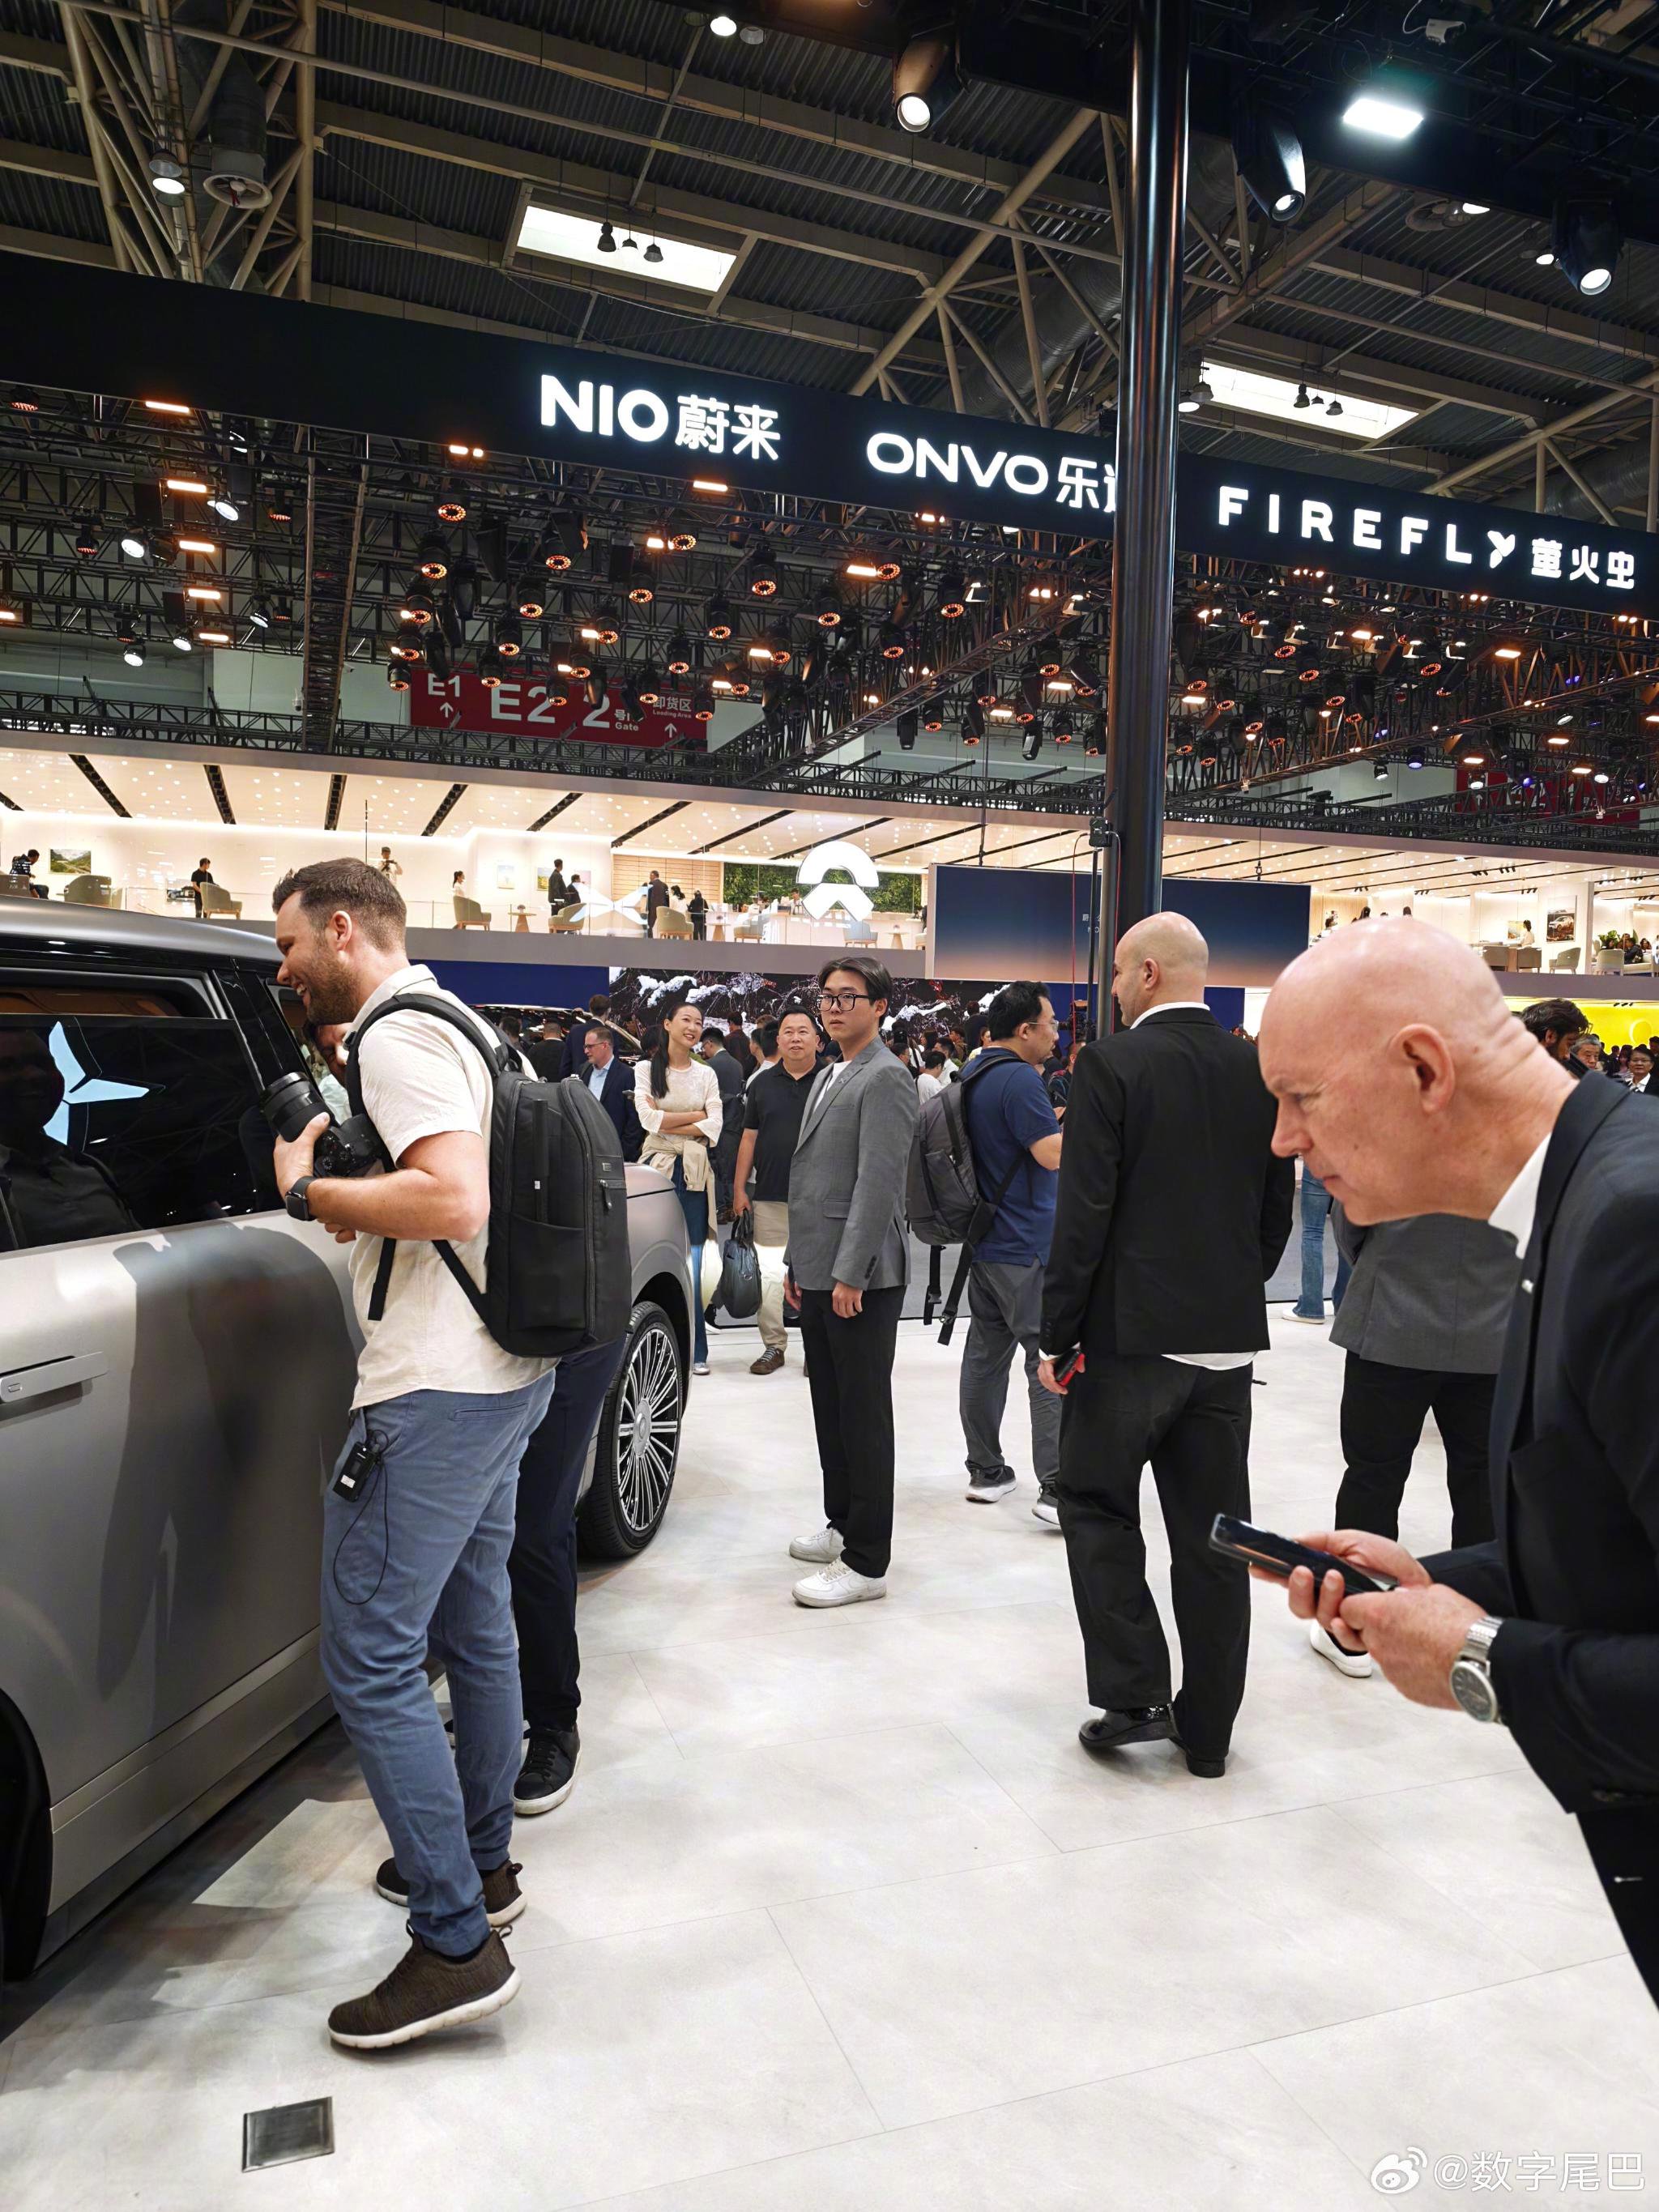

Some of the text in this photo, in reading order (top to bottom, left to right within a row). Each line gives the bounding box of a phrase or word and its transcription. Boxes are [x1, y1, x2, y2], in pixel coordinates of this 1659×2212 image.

[540, 373, 781, 461] NIO 蔚来
[866, 432, 1049, 495] ONVO
[1218, 485, 1635, 590] FIREFLY 萤火虫
[428, 673, 460, 697] E1
[491, 683, 556, 723] E2
[582, 693, 610, 728] 2
[615, 721, 639, 731] Gate
[653, 710, 676, 718] Loading
